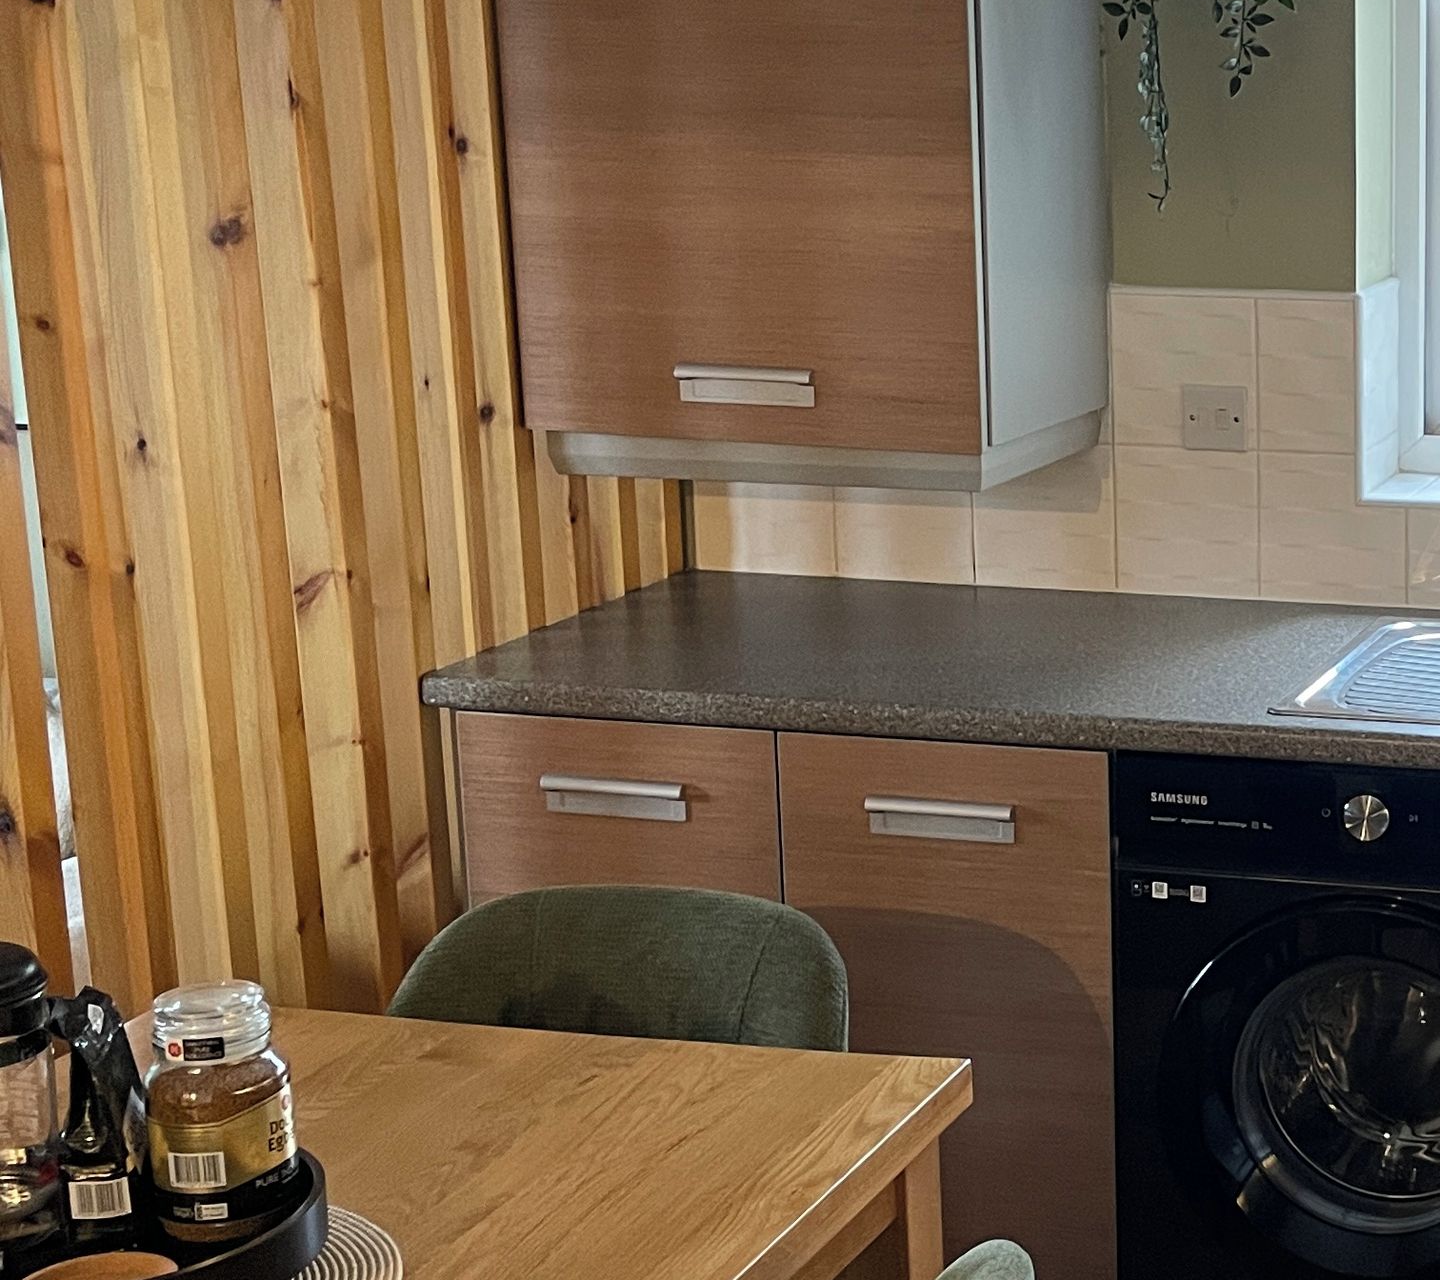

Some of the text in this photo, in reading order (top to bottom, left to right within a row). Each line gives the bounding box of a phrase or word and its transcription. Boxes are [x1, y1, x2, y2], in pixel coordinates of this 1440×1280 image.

[1150, 791, 1208, 806] SAMSUNG
[269, 1118, 287, 1135] Do
[268, 1131, 290, 1152] Egb
